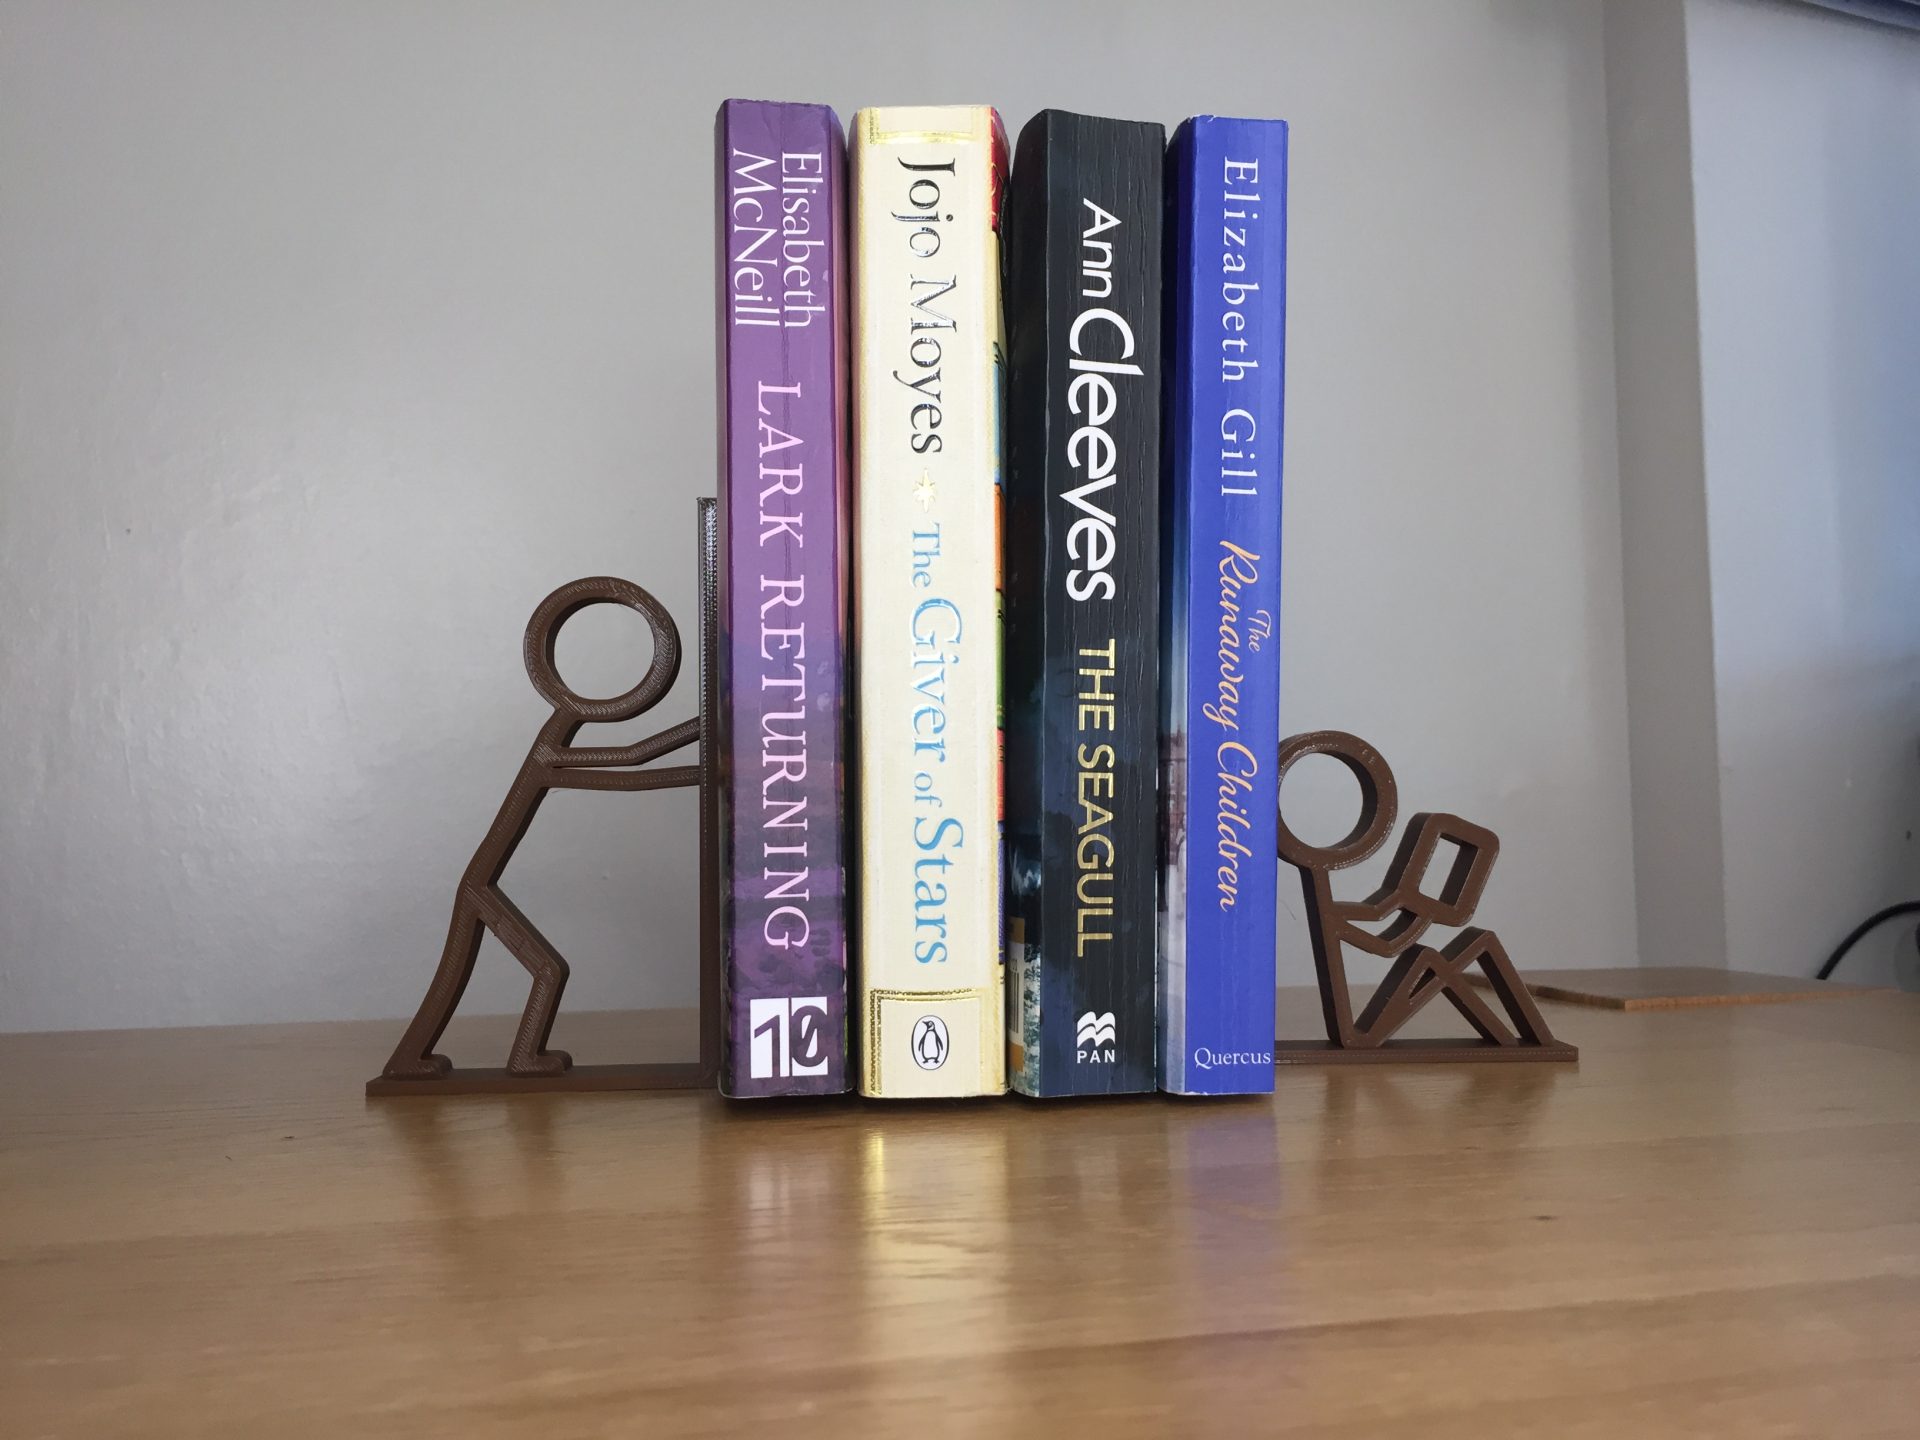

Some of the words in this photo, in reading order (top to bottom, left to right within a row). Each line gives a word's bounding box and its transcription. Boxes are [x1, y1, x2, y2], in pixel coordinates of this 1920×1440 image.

[732, 148, 780, 327] McNeill
[782, 151, 826, 328] Elisabeth
[891, 156, 957, 258] Jojo
[1082, 197, 1122, 297] Ann
[1221, 157, 1261, 383] Elizabeth
[892, 274, 957, 455] Moyes
[757, 380, 805, 548] LARK
[1059, 308, 1144, 602] Cleeves
[1220, 408, 1258, 497] Gill
[911, 521, 941, 588] The
[1202, 540, 1262, 733] Runaway
[1245, 608, 1273, 654] The
[759, 575, 810, 950] RETURNING
[908, 597, 964, 763] Giver
[1077, 638, 1116, 731] THE
[913, 773, 942, 807] of
[1076, 744, 1116, 957] SEAGULL
[1217, 740, 1260, 912] Children
[914, 817, 963, 965] Stars
[1076, 1049, 1116, 1064] PAN
[1194, 1047, 1271, 1068] Quercus
